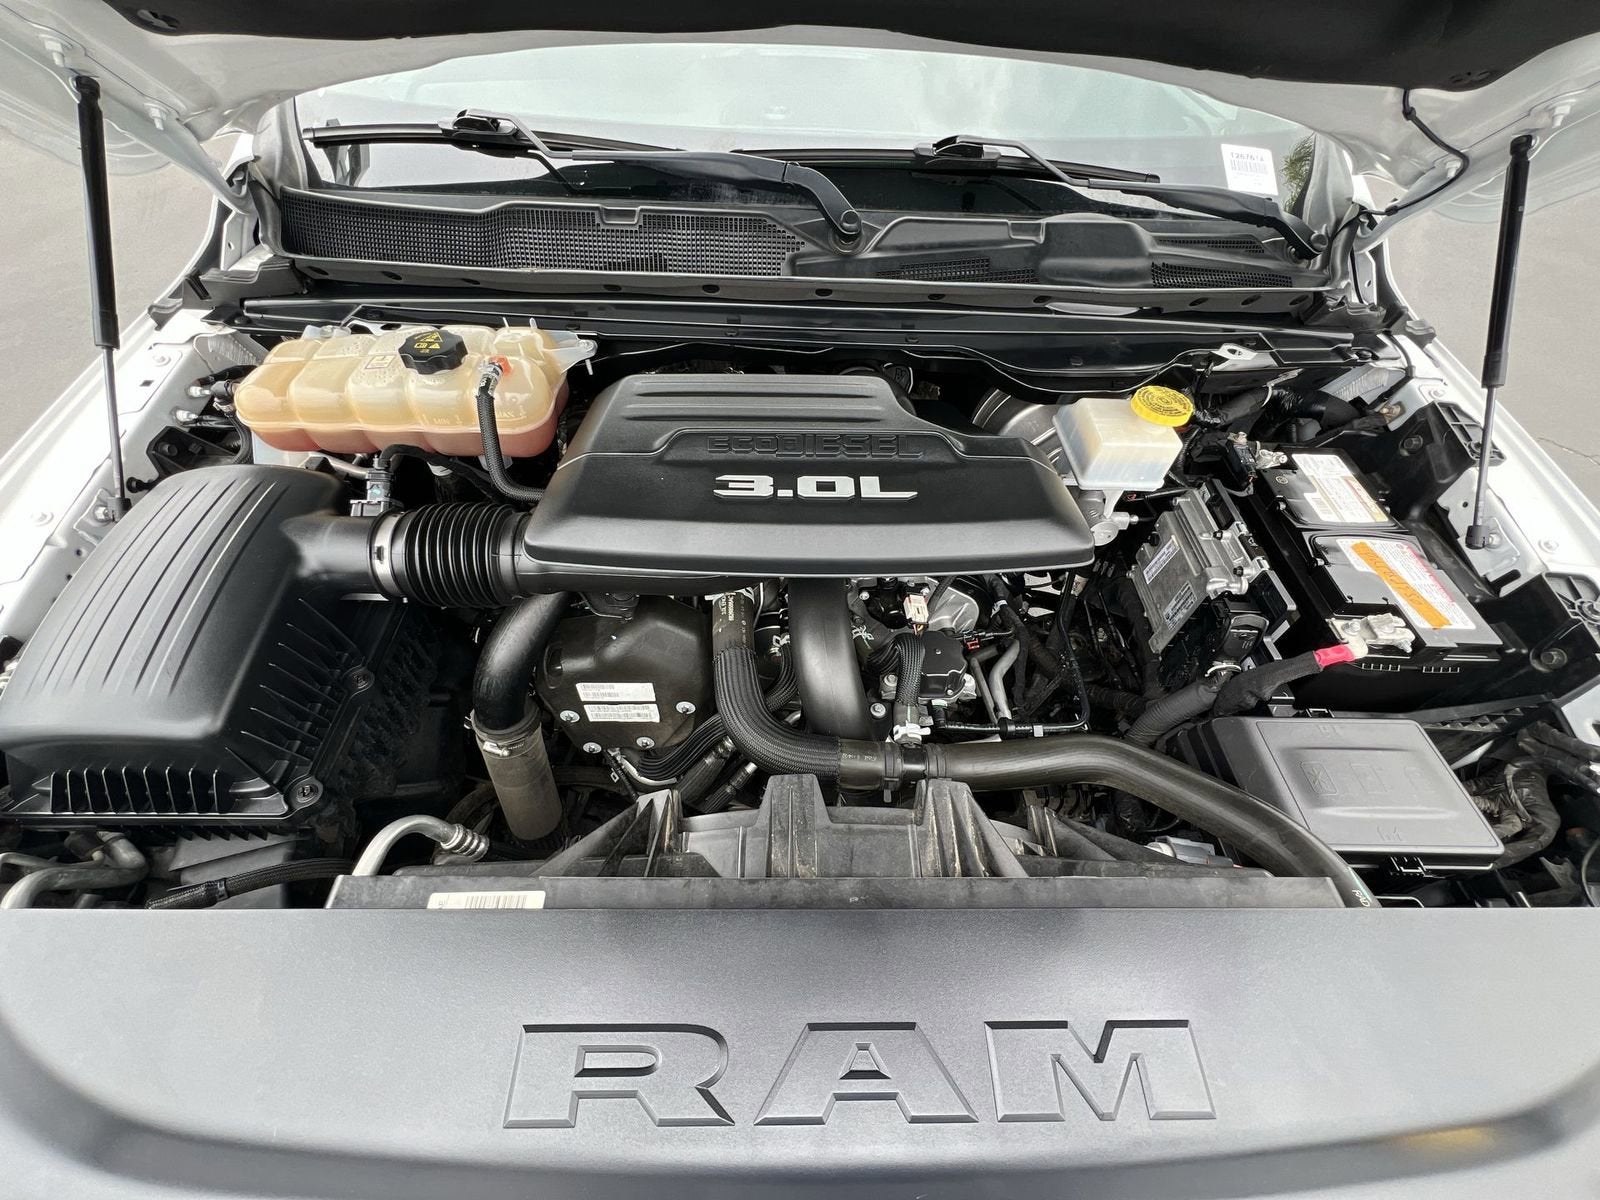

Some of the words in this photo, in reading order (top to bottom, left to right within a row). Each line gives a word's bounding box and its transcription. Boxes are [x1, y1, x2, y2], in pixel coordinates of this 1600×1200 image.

[707, 434, 924, 458] ECODIESEL
[713, 475, 918, 500] 3.0L
[502, 1020, 1218, 1128] RAM
